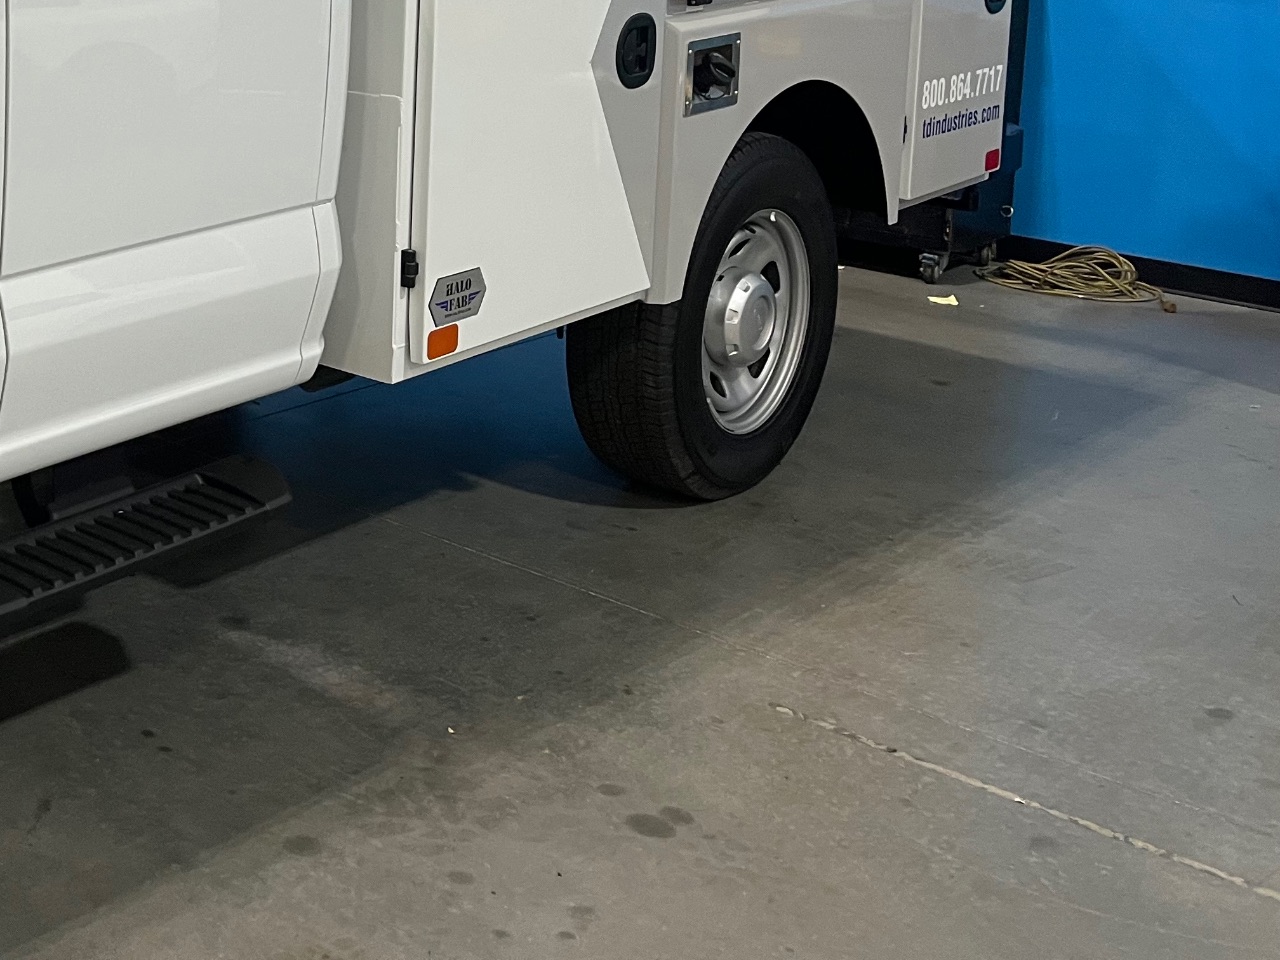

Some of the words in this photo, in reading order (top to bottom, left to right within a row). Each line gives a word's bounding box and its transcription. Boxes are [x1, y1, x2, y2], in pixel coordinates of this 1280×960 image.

[921, 64, 1004, 110] 800.864.7717
[922, 104, 1000, 139] tdindustries.com
[445, 278, 472, 297] HALO
[449, 295, 468, 311] FAB
